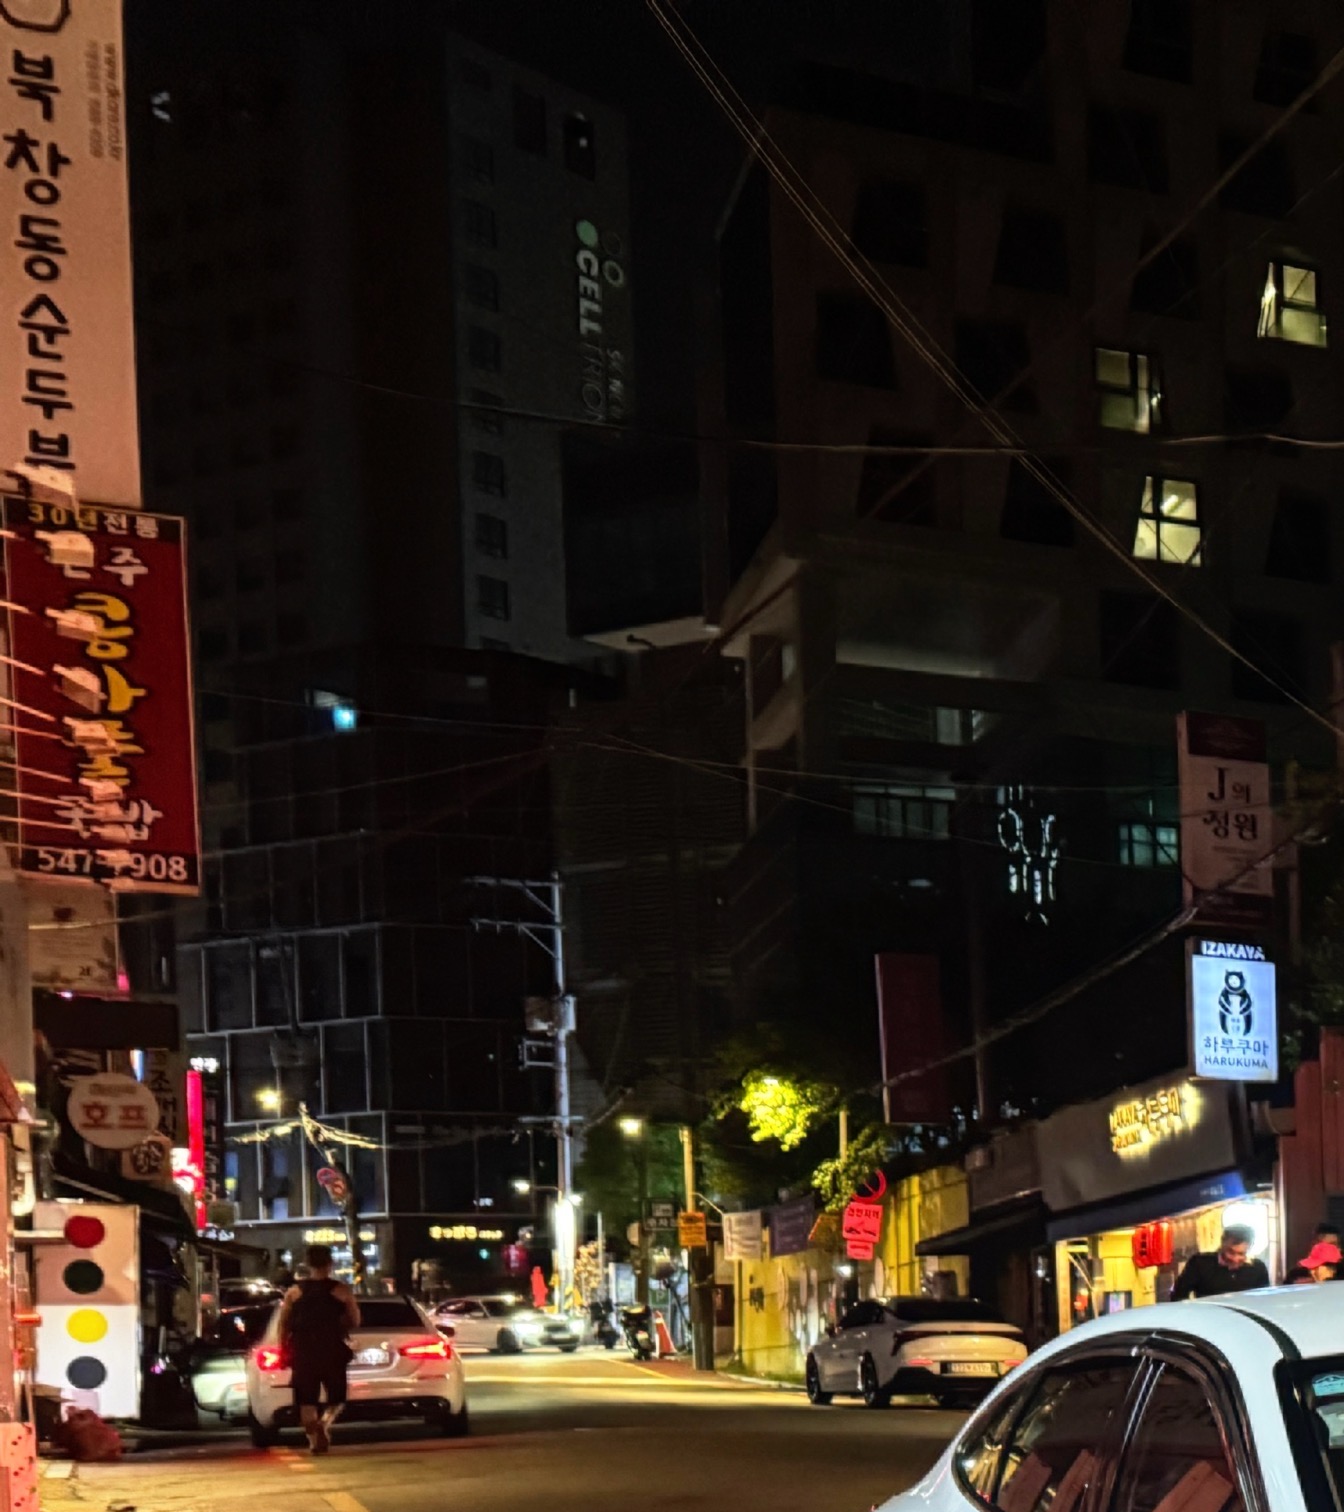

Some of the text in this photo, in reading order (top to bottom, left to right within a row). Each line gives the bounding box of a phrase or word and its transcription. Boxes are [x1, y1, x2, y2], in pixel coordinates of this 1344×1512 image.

[1203, 810, 1259, 841] 정원
[1201, 941, 1265, 960] IZAKAYA
[1204, 1055, 1269, 1069] HARUKUMA
